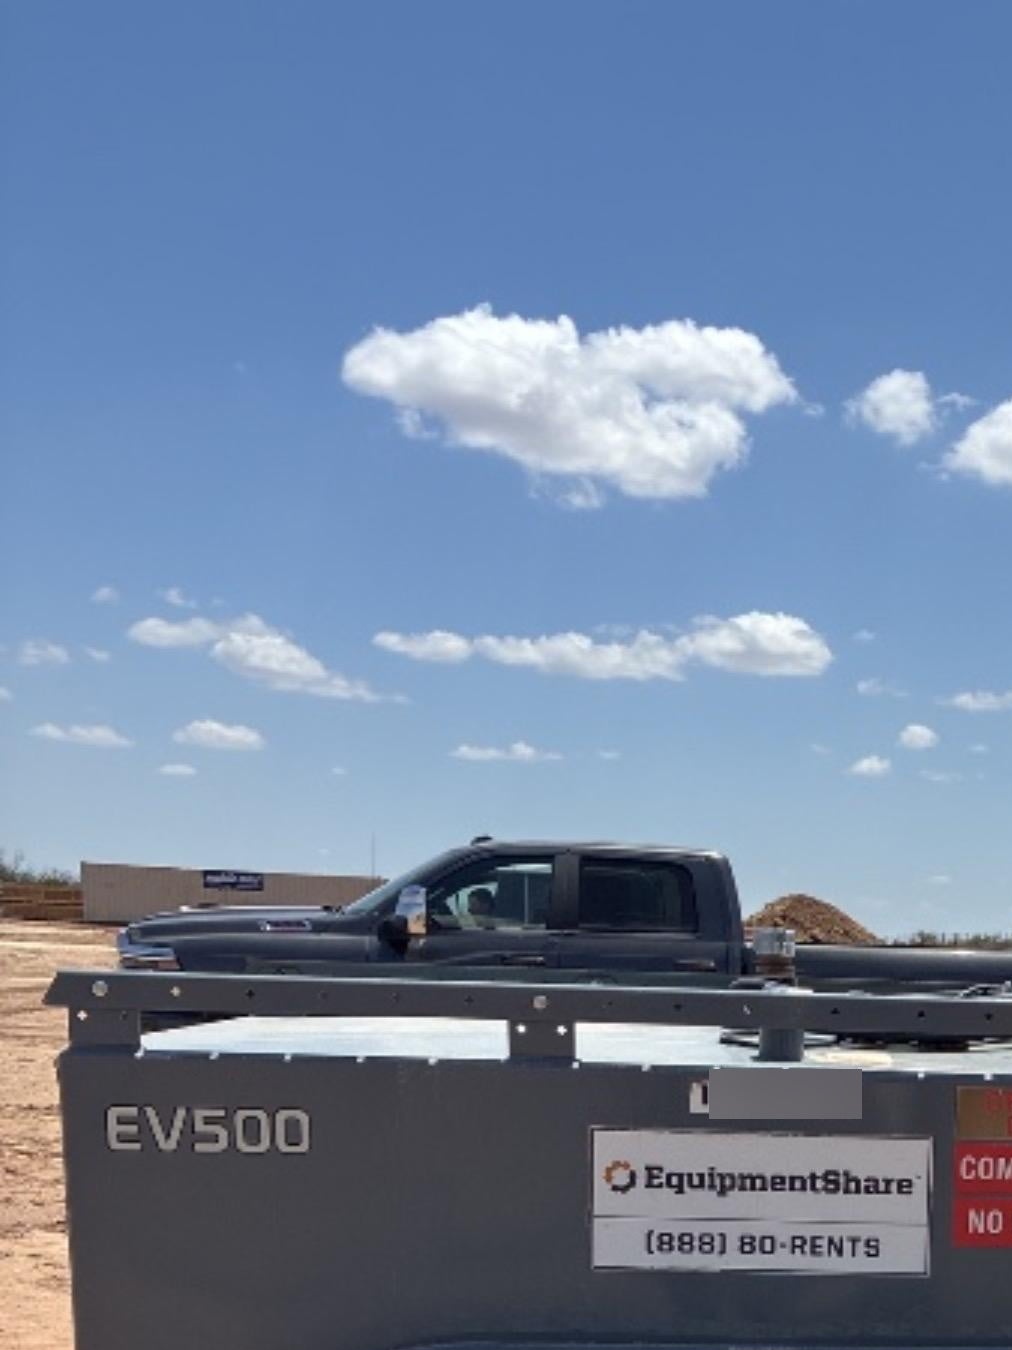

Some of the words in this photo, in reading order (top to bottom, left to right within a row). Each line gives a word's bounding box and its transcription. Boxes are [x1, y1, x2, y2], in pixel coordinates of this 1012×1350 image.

[106, 1105, 311, 1154] EV500
[644, 1165, 915, 1199] EquipmentShare
[968, 1209, 1003, 1234] NO
[646, 1229, 727, 1256] (888)
